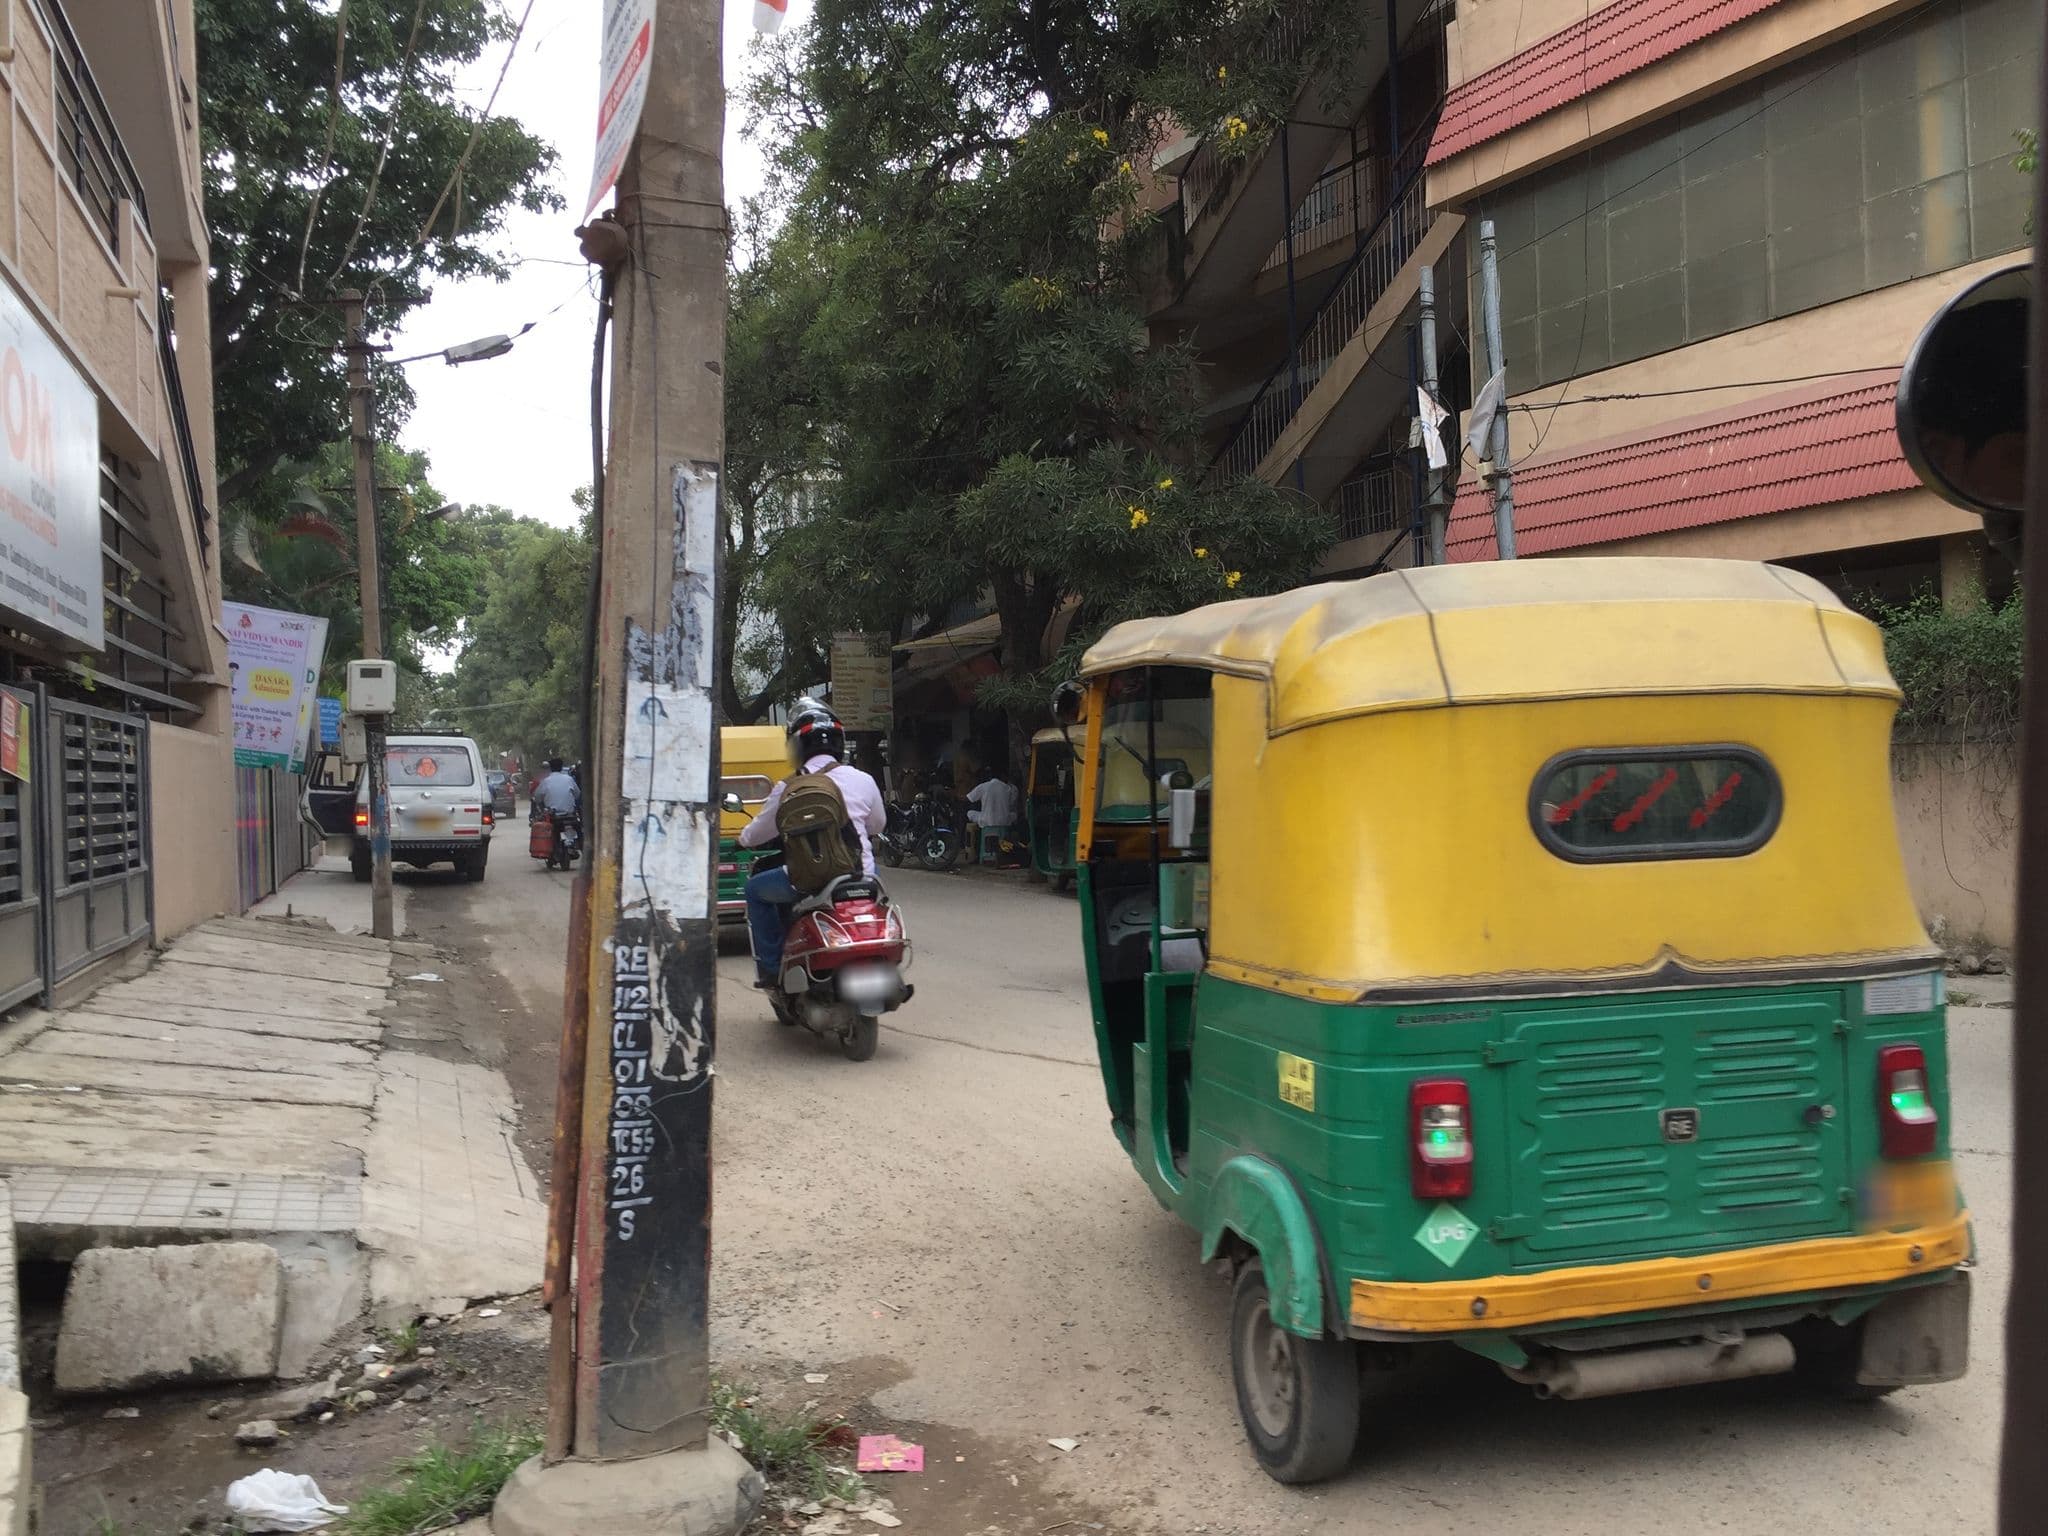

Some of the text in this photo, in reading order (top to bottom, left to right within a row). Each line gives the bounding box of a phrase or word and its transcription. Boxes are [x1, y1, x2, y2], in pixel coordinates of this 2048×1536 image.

[243, 631, 268, 642] VIDYA
[269, 636, 304, 649] MANDIR
[255, 674, 290, 686] DASARA
[611, 1164, 644, 1196] 26
[618, 1209, 636, 1241] S
[1428, 1223, 1466, 1244] LPG
